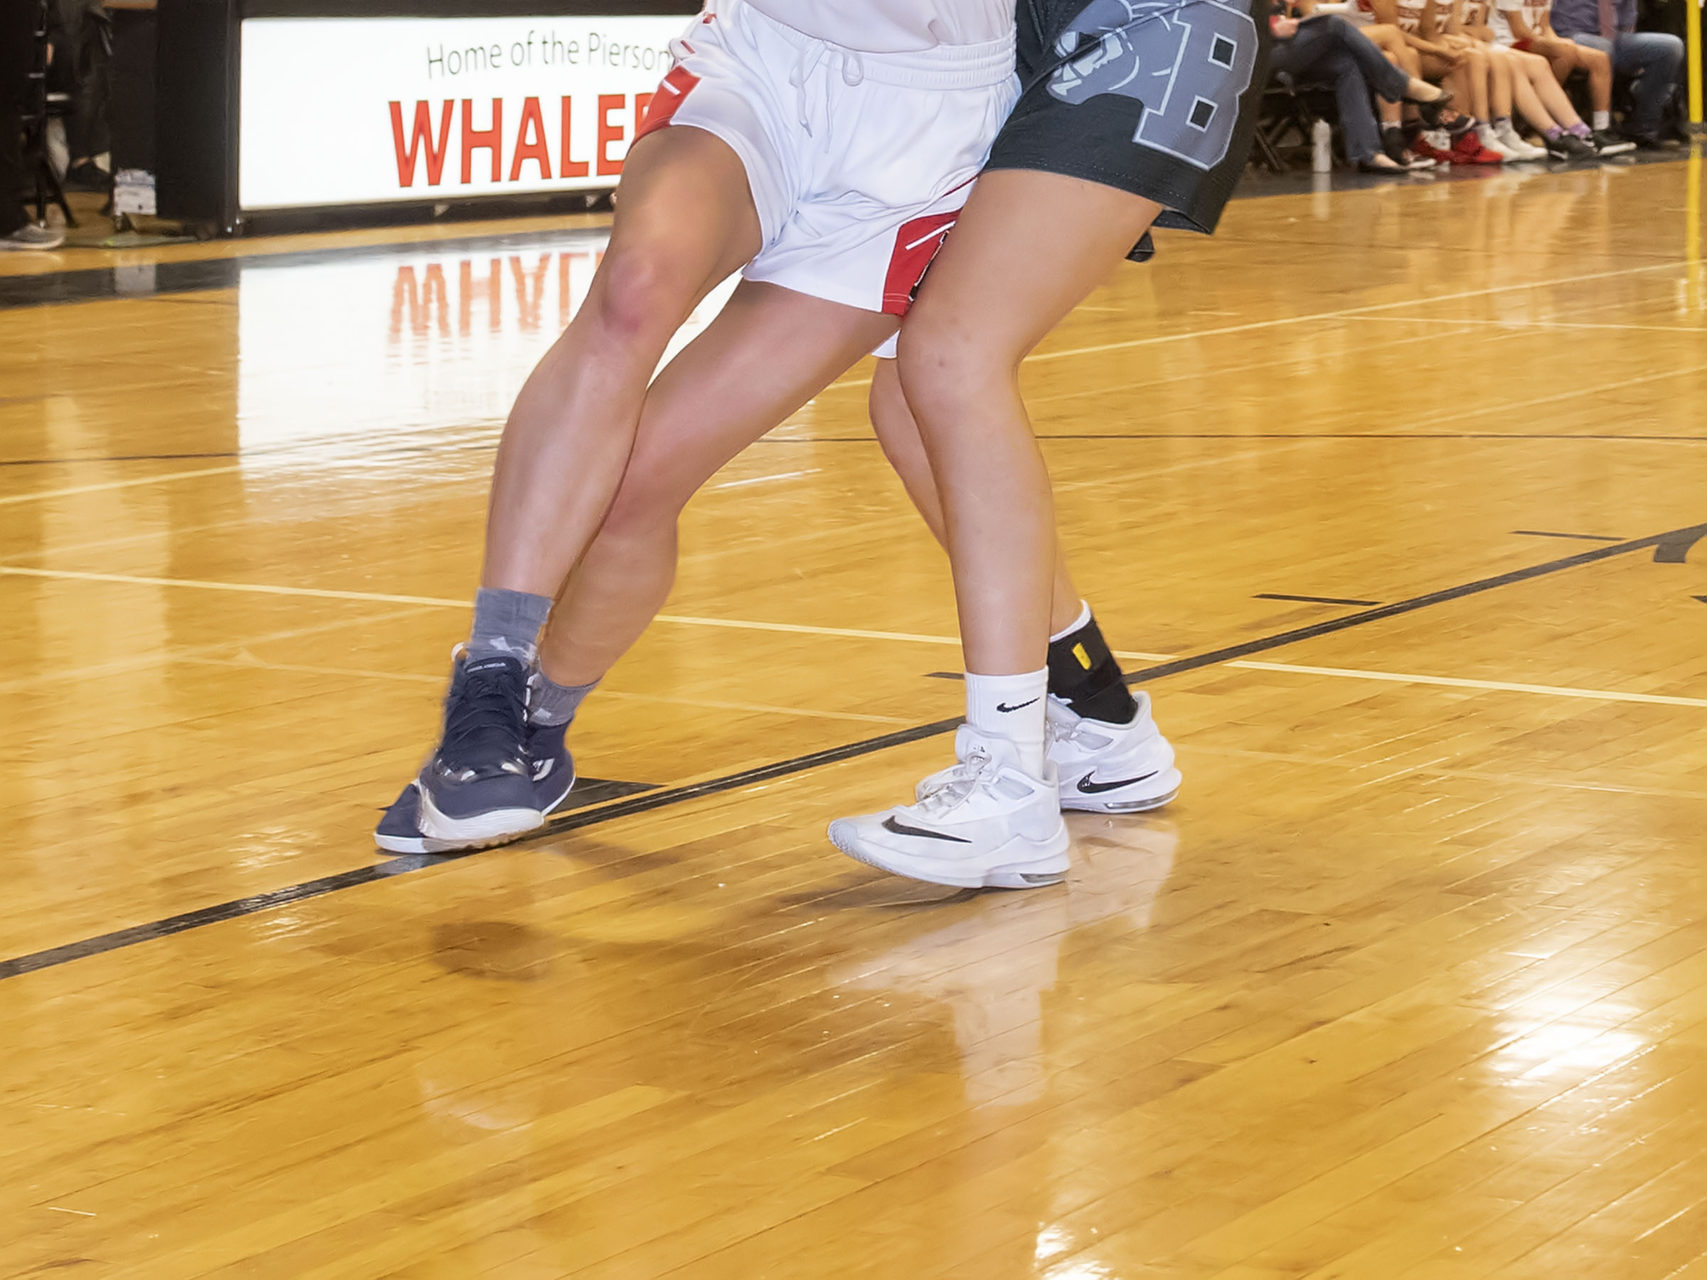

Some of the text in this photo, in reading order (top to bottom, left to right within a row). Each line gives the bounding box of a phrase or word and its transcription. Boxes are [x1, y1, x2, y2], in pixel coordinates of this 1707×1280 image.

[426, 30, 672, 79] Home of the Pierson
